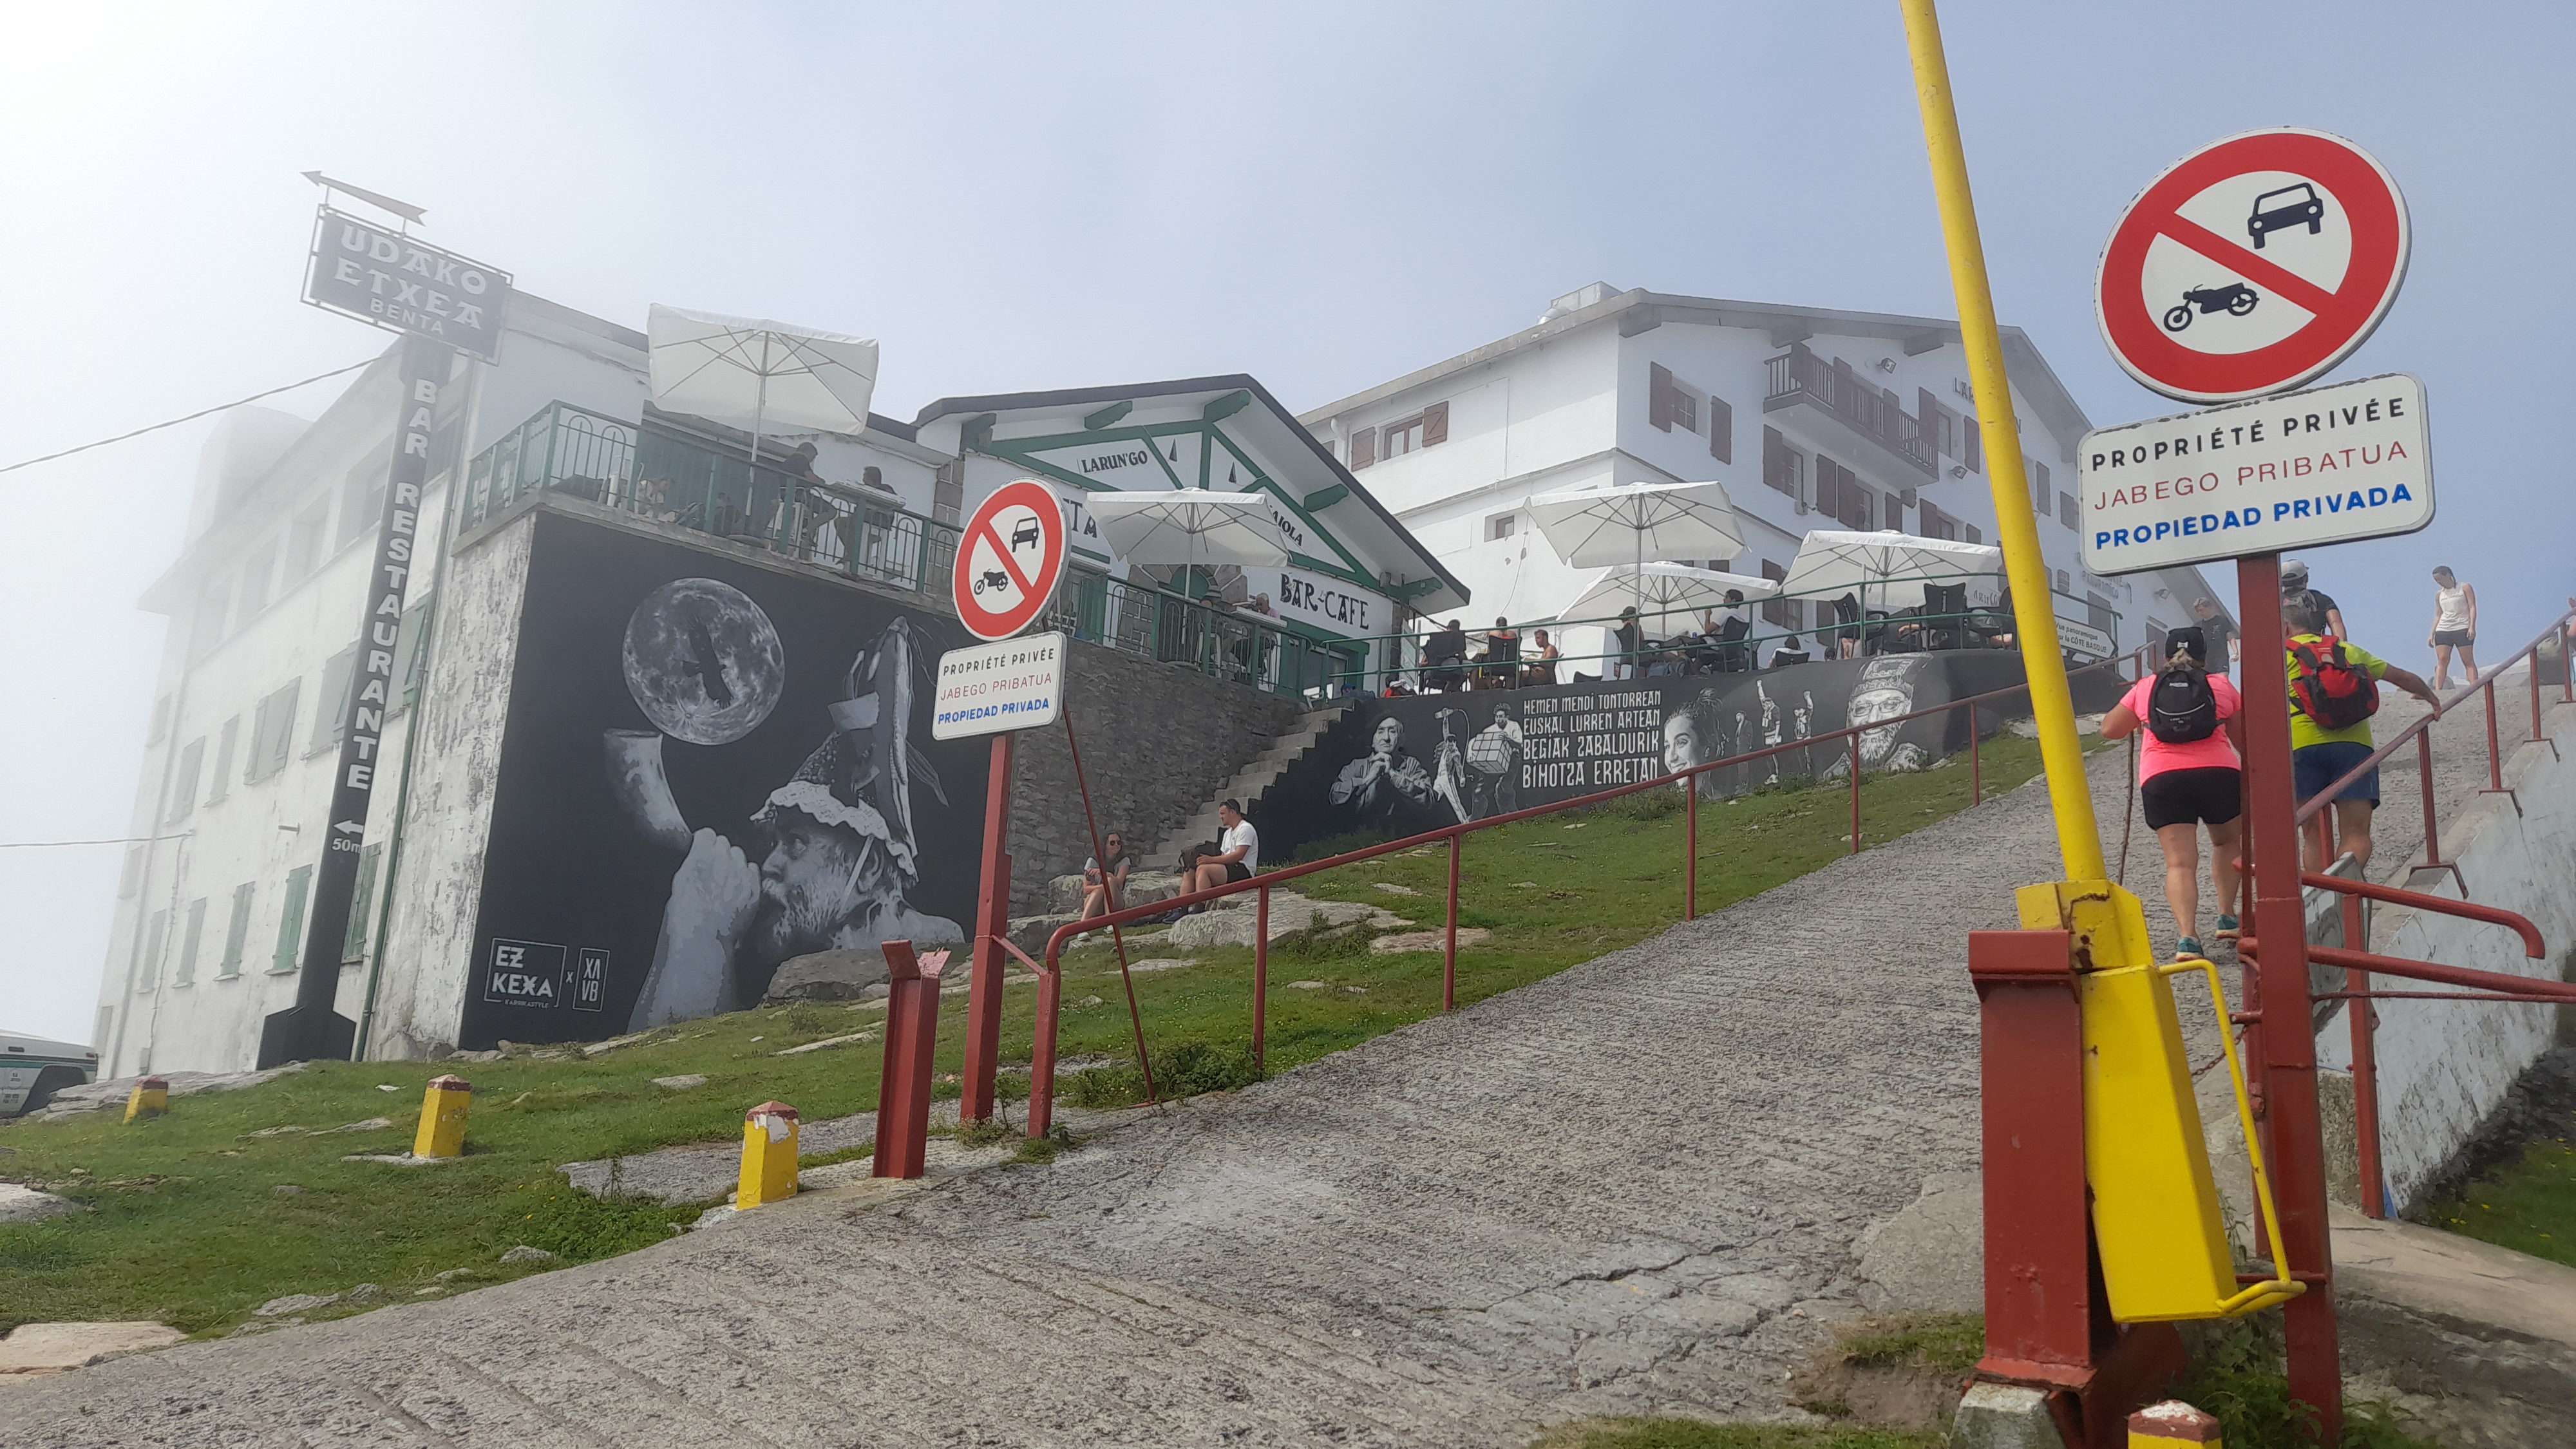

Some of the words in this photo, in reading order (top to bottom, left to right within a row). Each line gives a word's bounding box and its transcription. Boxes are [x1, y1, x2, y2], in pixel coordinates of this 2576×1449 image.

[341, 224, 486, 295] UDAKO
[334, 256, 482, 330] ETXEA
[370, 298, 444, 335] BENTA
[404, 379, 437, 459] BAR
[2092, 421, 2265, 471] PROPRIÉTÉ
[2284, 397, 2405, 437] PRIVÉE
[2094, 472, 2219, 510] JABEGO
[2238, 441, 2407, 486] PRIBATUA
[1270, 505, 1303, 547] AIOLA
[2096, 507, 2261, 550] PROPIEDAD
[2274, 483, 2412, 522] PRIVADA
[346, 482, 420, 790] RESTAURANTE
[2086, 641, 2107, 653] BASQUE
[943, 654, 1005, 676] PROPRIÉTÉ
[1012, 648, 1054, 665] PRIVÉE
[941, 683, 987, 701] JABEGO
[992, 672, 1052, 692] PRIBATUA
[1524, 698, 1557, 715] HEMEN
[1562, 692, 1594, 712] MENDI
[1598, 690, 1661, 709] TONTORREAN
[938, 705, 998, 724] PROPIEDAD
[1001, 697, 1049, 714] PRIVADA
[1524, 717, 1564, 735] EUSKAL
[1570, 712, 1612, 733] LURREN
[1618, 709, 1660, 729] ARTEAN
[1524, 734, 1569, 760] BEGIAK
[1577, 727, 1659, 757] ZABALDURIK
[1522, 759, 1585, 789] BIHOTZA
[1594, 757, 1658, 785] ERRETAN
[332, 839, 361, 854] 50m
[492, 972, 553, 997] KEXA
